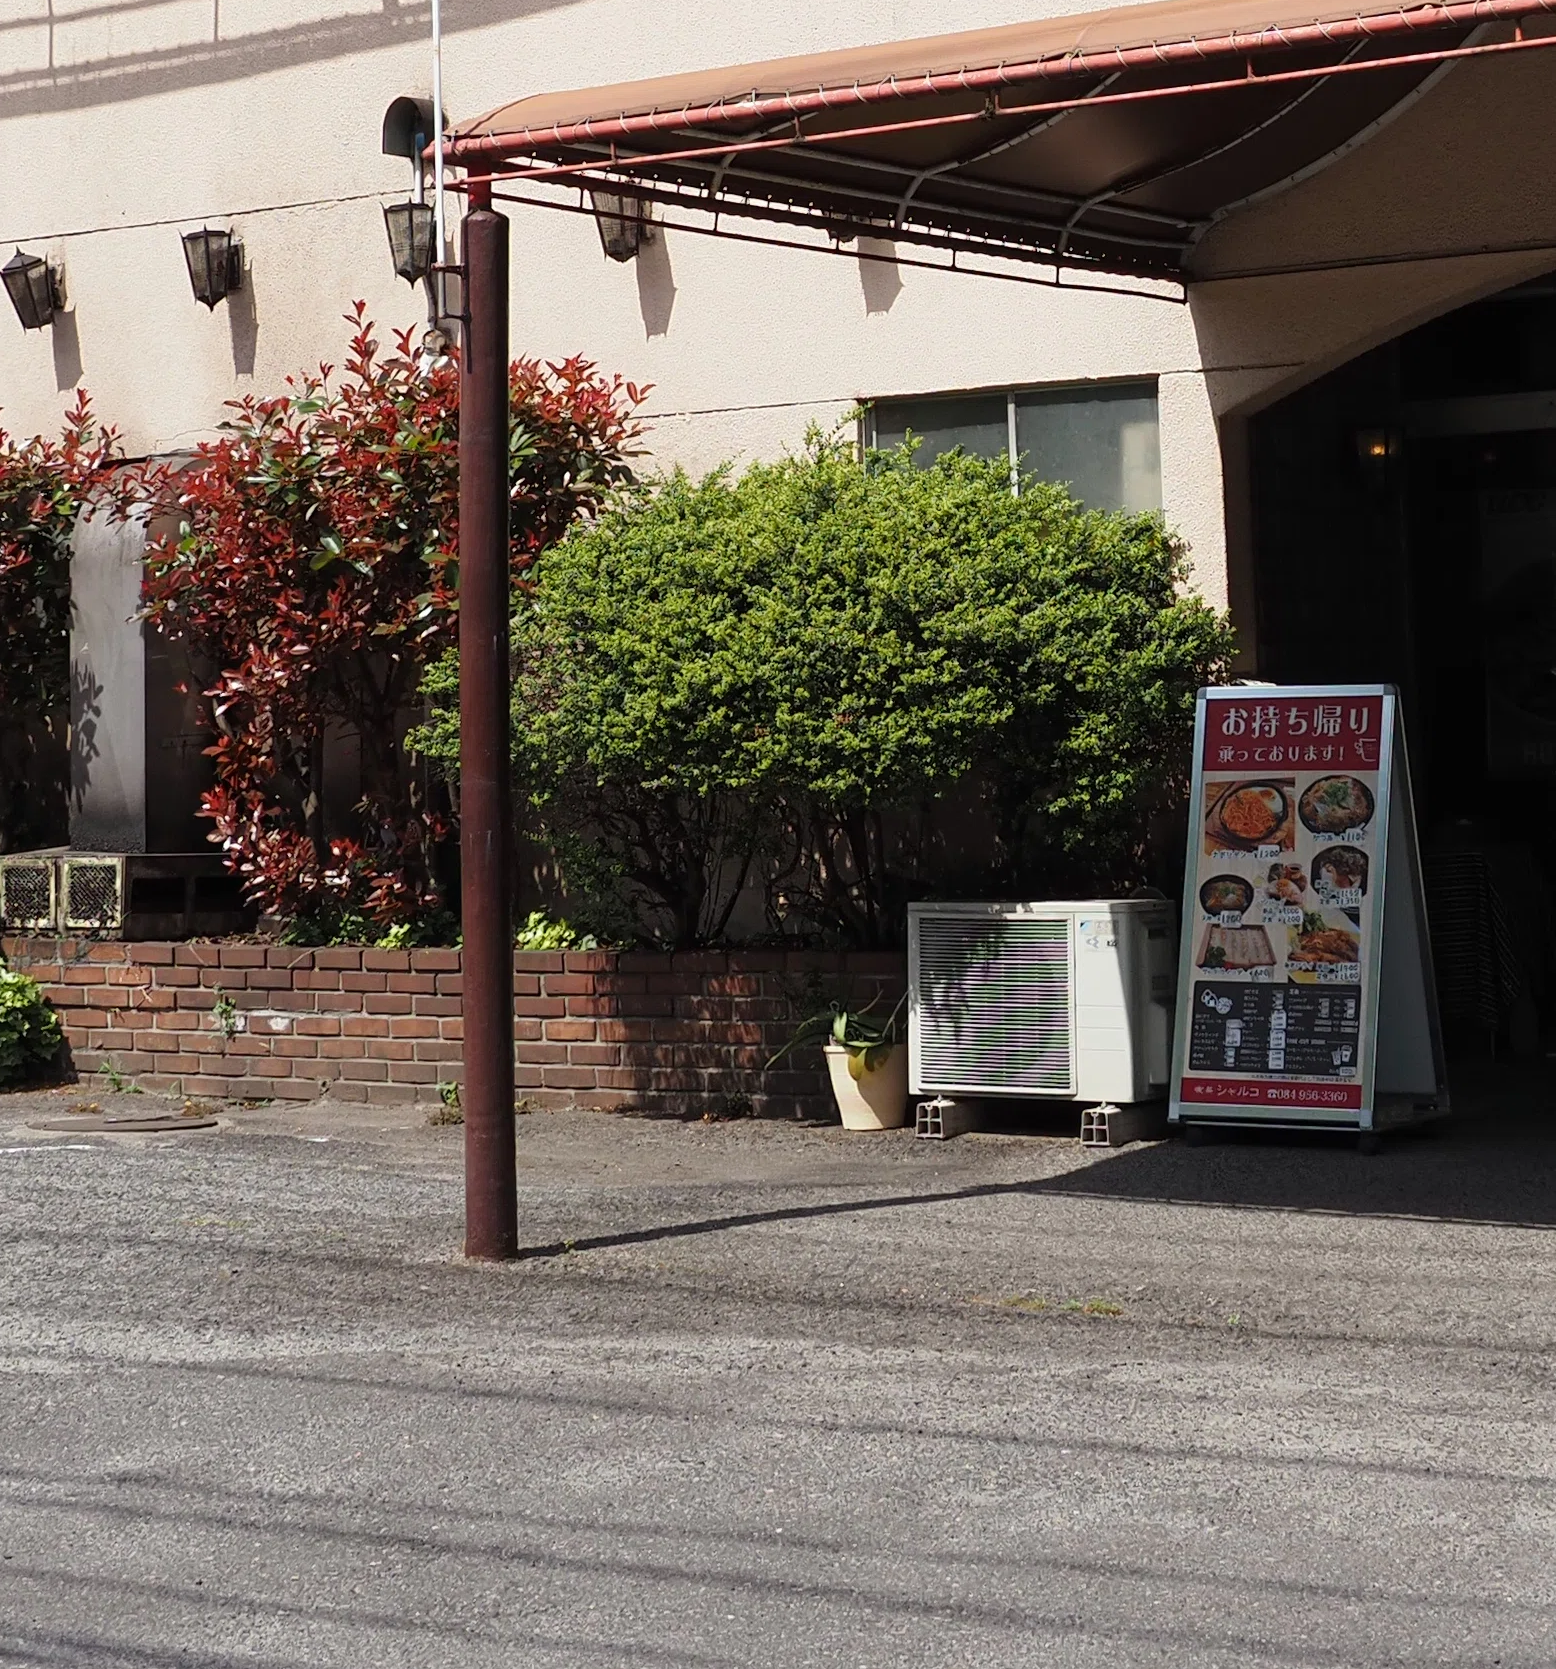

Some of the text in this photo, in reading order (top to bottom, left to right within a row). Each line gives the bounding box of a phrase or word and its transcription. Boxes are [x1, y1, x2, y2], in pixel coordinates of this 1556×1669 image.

[1221, 705, 1369, 739] お持ち帰り
[1217, 1084, 1260, 1097] シャルコ
